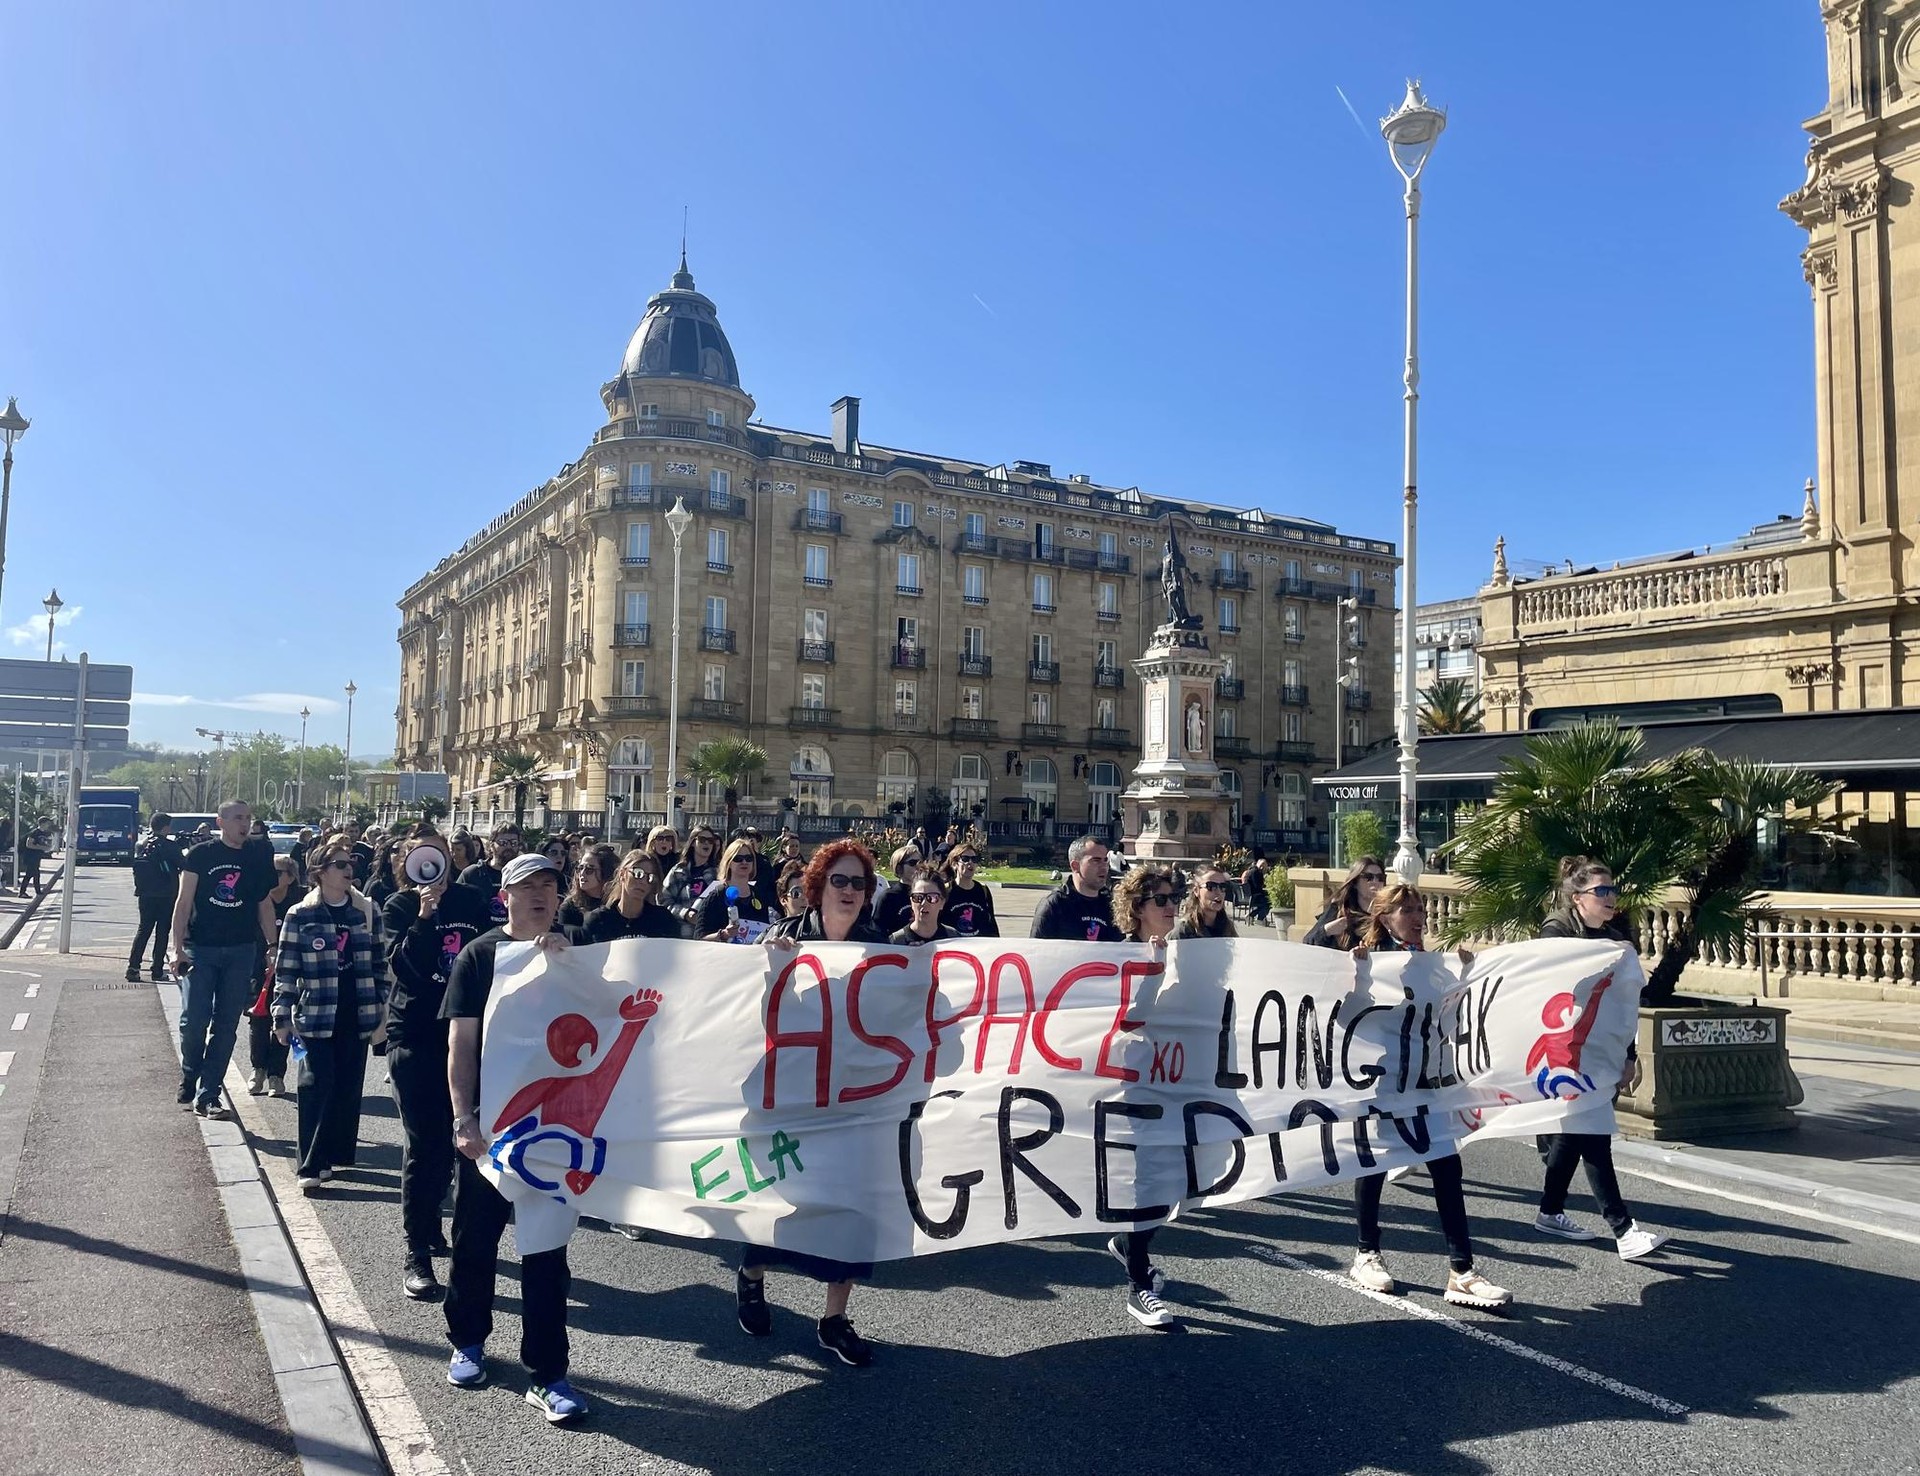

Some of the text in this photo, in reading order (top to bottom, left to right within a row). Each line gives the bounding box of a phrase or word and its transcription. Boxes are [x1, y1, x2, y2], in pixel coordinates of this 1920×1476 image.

[1328, 784, 1379, 799] VICTORIA CAFÉ
[763, 951, 1165, 1109] ASPACE
[691, 1129, 804, 1202] ELA
